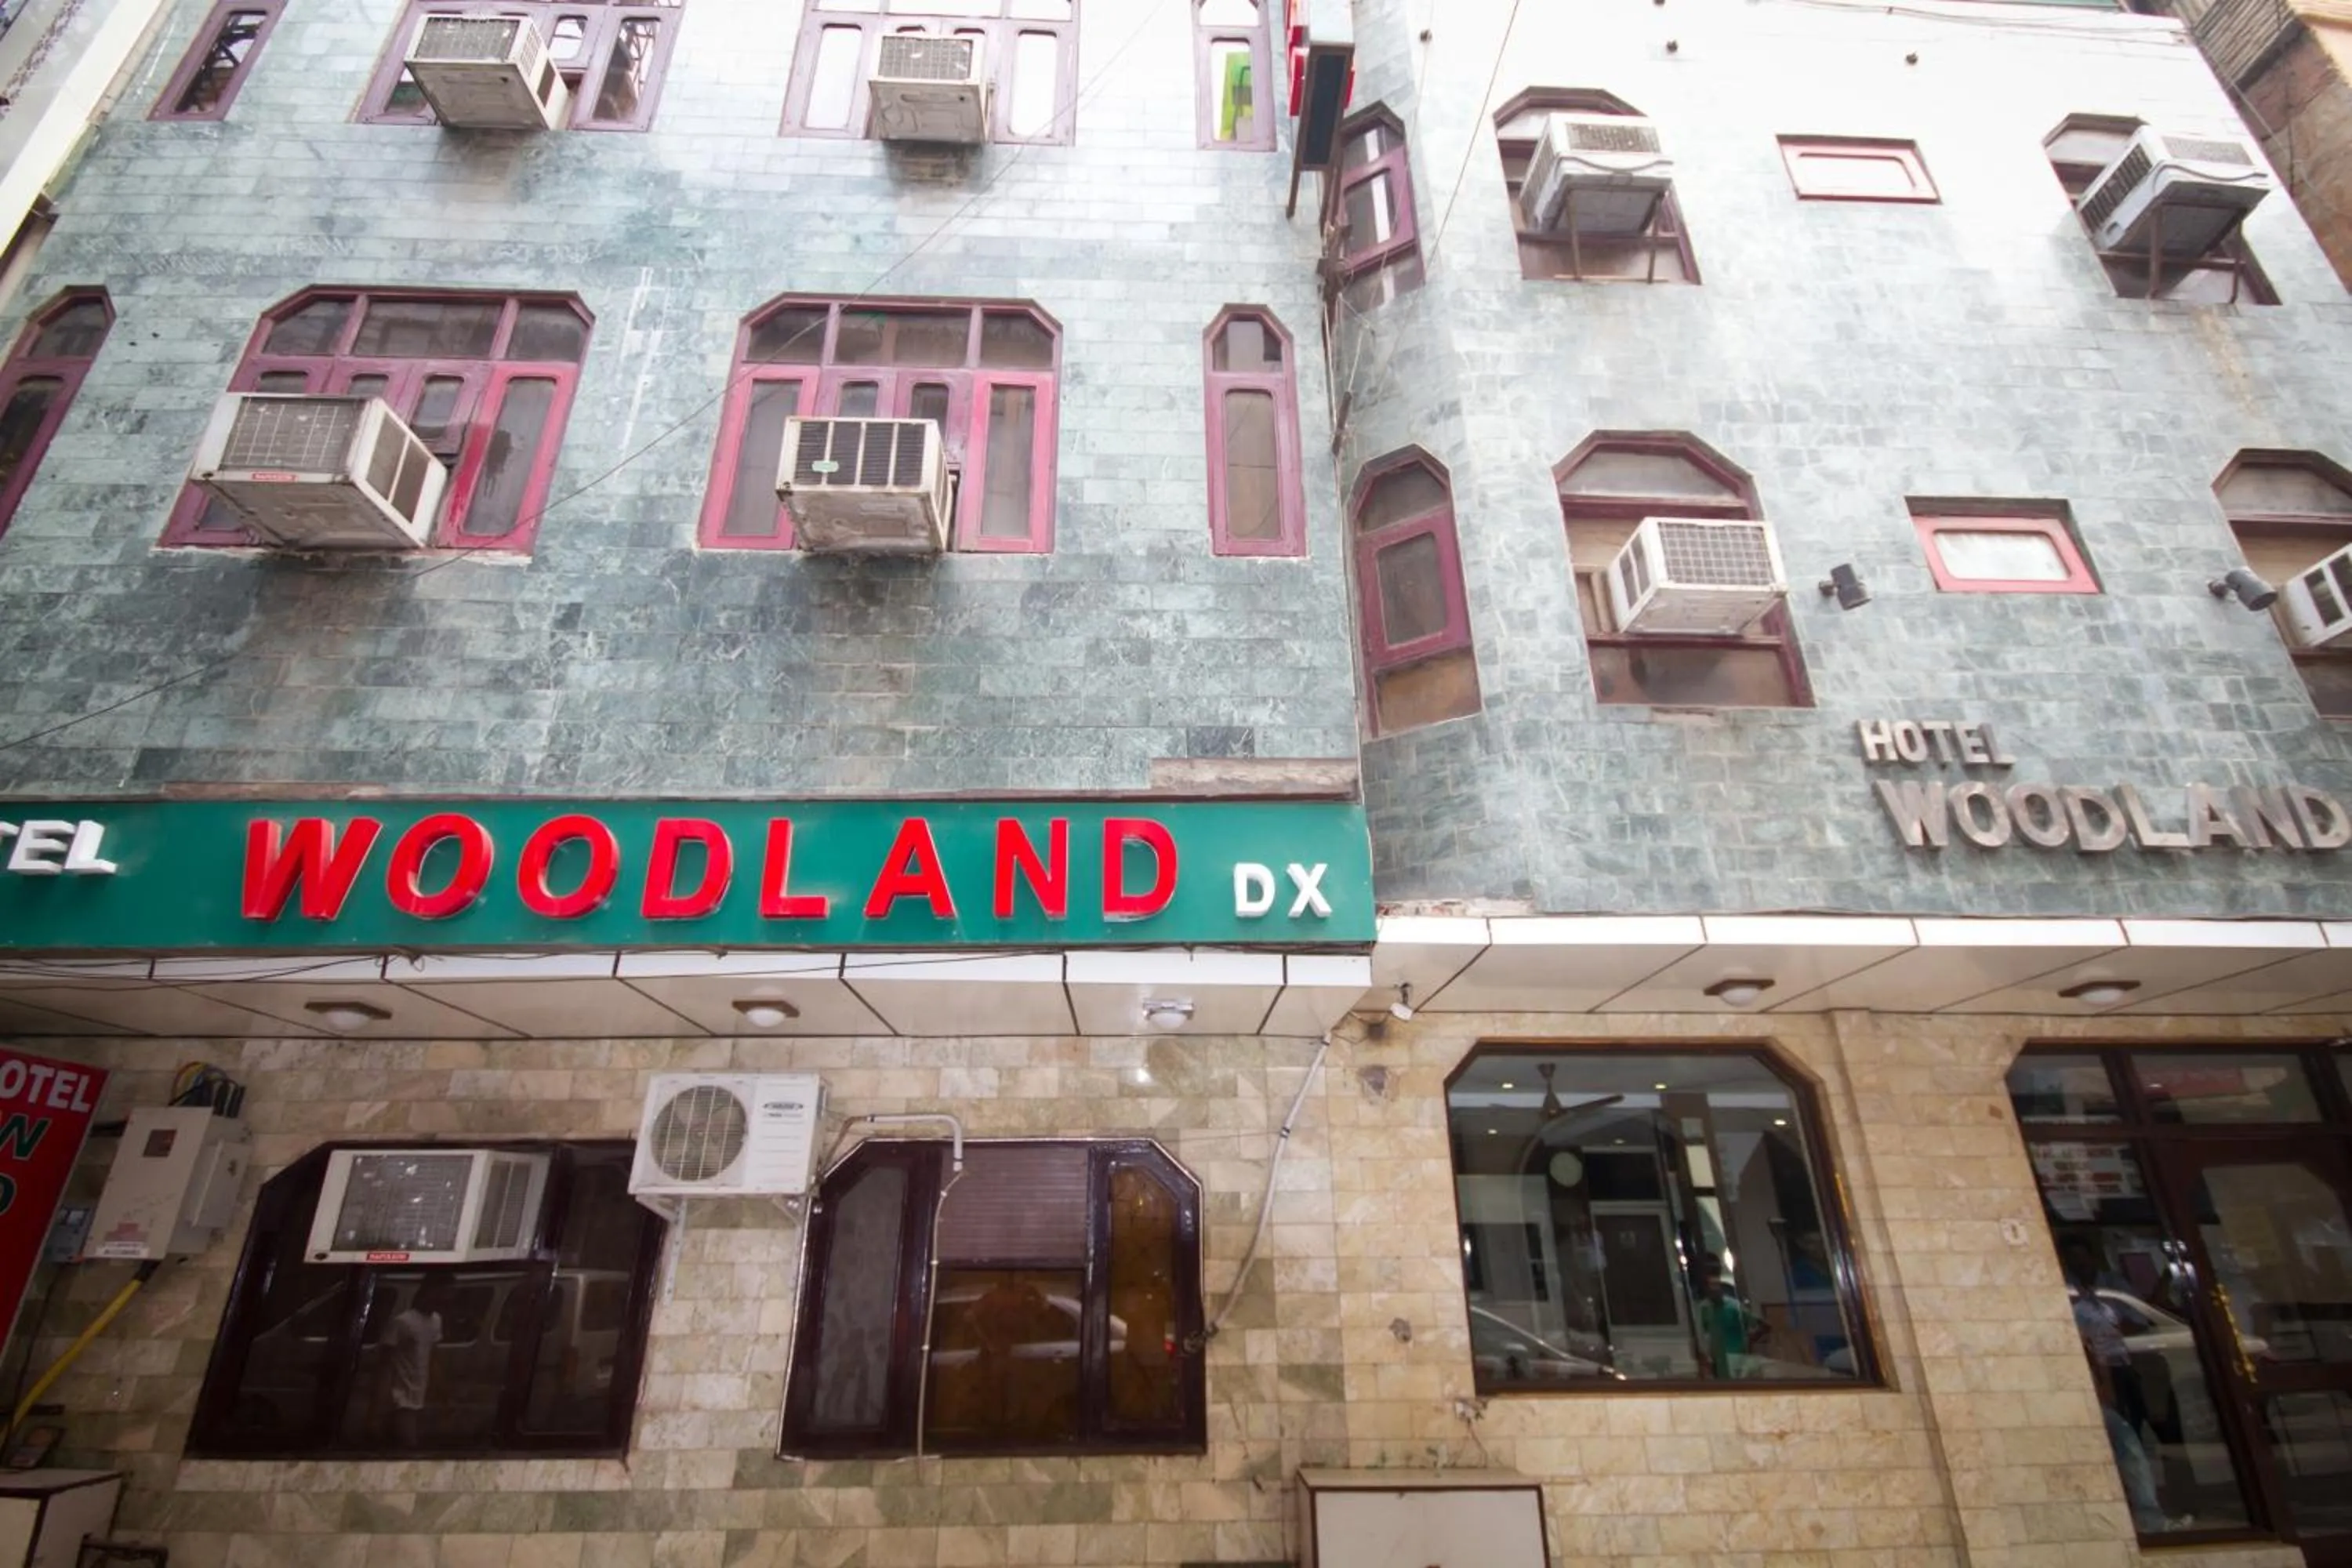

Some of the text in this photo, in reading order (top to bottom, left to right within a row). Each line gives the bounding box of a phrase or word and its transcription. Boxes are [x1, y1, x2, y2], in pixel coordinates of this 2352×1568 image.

[1856, 718, 2016, 767] HOTEL
[1873, 781, 2351, 851] WOODLAND
[241, 813, 1178, 923] WOODLAND
[1233, 862, 1332, 917] DX
